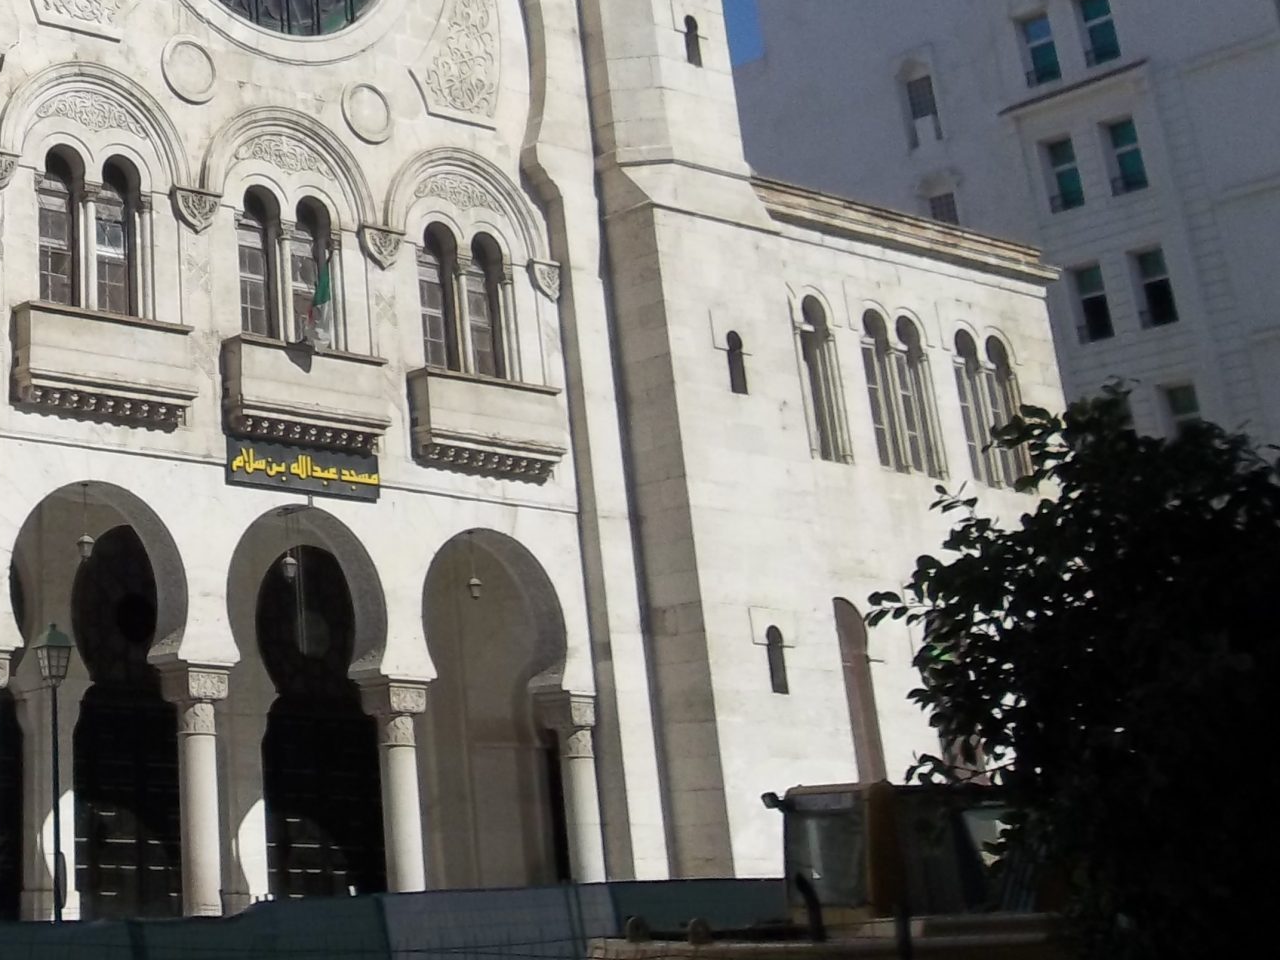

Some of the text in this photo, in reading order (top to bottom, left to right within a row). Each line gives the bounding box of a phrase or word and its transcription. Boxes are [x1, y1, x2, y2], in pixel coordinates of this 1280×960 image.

[232, 447, 266, 473] سلام
[266, 457, 286, 479] بن
[341, 469, 379, 489] مسجد
